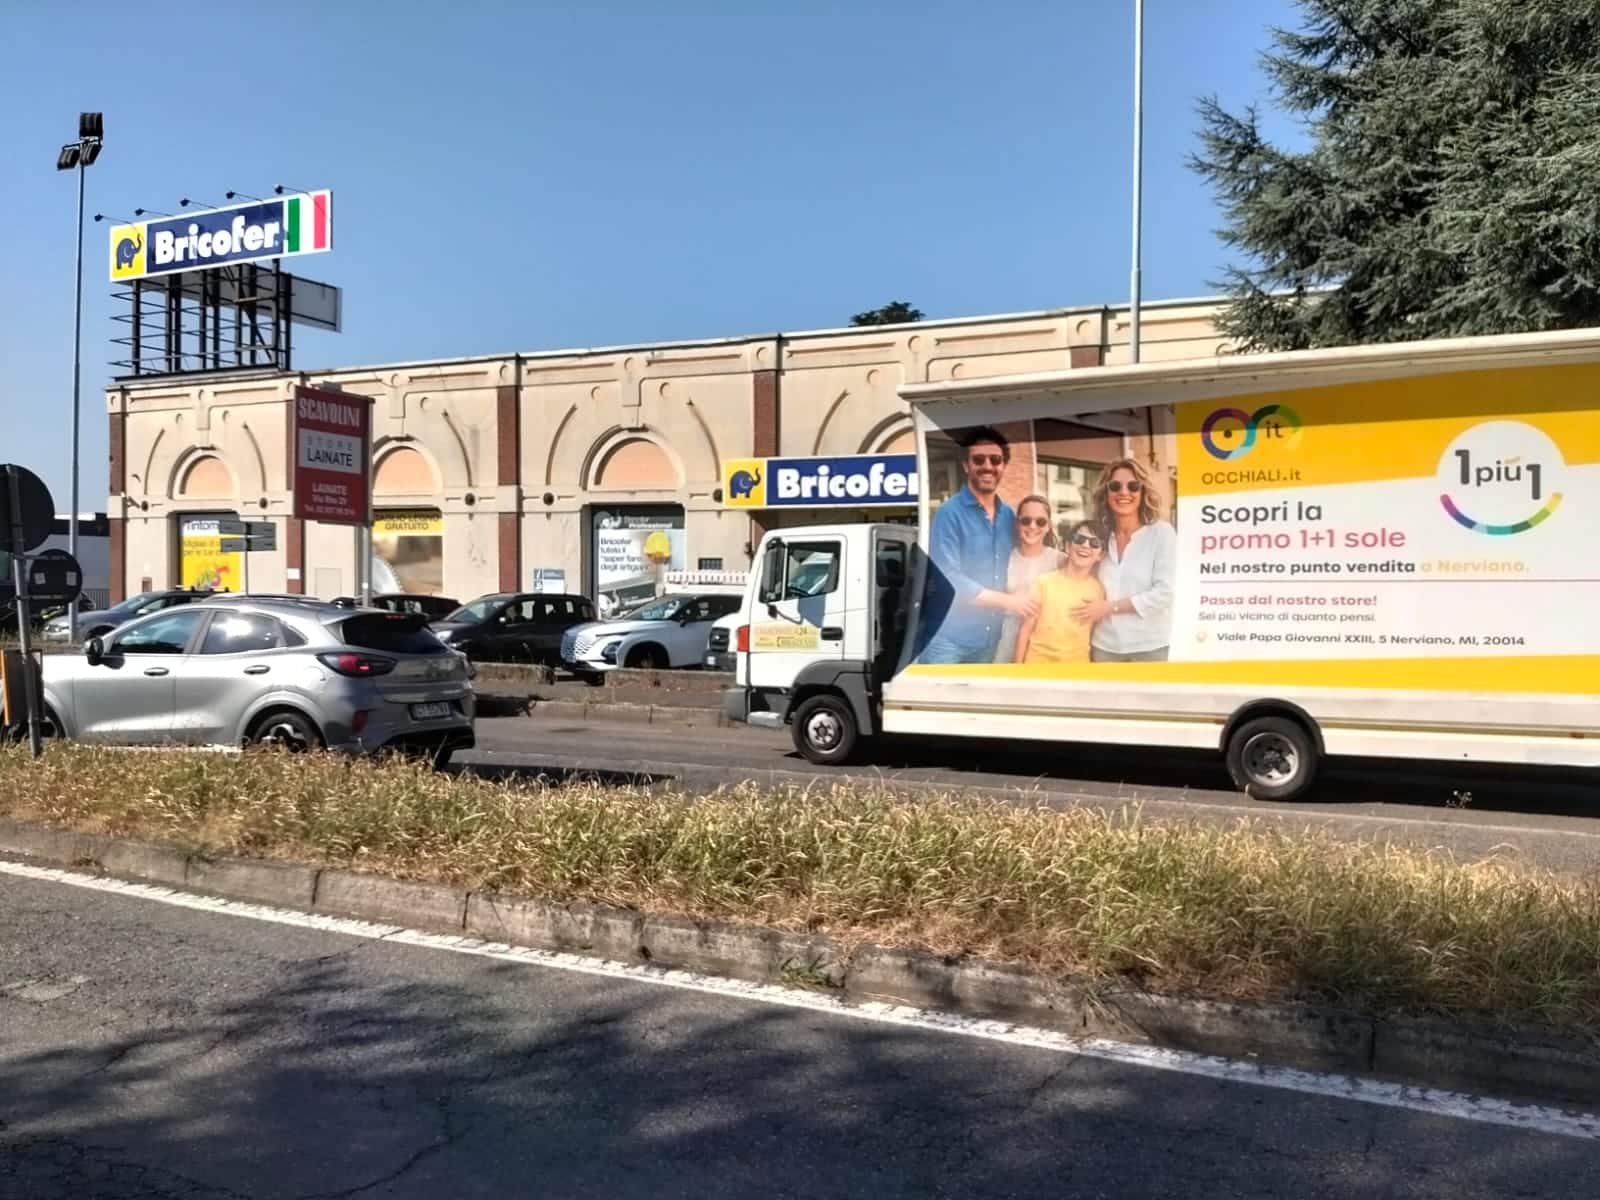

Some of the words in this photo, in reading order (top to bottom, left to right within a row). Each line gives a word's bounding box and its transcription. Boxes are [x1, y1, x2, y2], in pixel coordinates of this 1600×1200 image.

[155, 215, 280, 264] Bricofer
[299, 398, 361, 427] SCAVOLINI
[1265, 420, 1284, 439] it
[306, 434, 353, 452] STORE
[307, 447, 353, 468] LAINATE
[777, 462, 919, 499] Bricofer
[1201, 468, 1303, 485] OCCHIALI.it
[1200, 501, 1289, 527] Scopri
[1297, 500, 1323, 521] la
[384, 521, 429, 530] GRATUITO
[1200, 532, 1292, 555] promo
[1299, 528, 1336, 549] 1+1
[1344, 527, 1407, 549] sole
[1199, 561, 1226, 575] Nel
[1230, 561, 1286, 575] nostro
[1289, 561, 1342, 576] punto
[1346, 559, 1416, 574] vendita
[1420, 562, 1433, 573] a
[1199, 594, 1244, 606] Passa
[1247, 594, 1273, 606] dal
[1276, 595, 1327, 606] nostro
[1330, 595, 1378, 607] store!
[1198, 611, 1216, 622] Sei
[1239, 611, 1275, 622] vicino
[1278, 611, 1290, 622] di
[1291, 612, 1337, 623] quanto
[1339, 612, 1377, 624] pensi.
[1216, 631, 1247, 643] Viale
[1249, 632, 1282, 644] Papa
[1284, 632, 1341, 644] Giovanni
[1378, 634, 1388, 644] 5
[1390, 634, 1456, 646] Nerviano,
[1483, 635, 1526, 646] 20014
